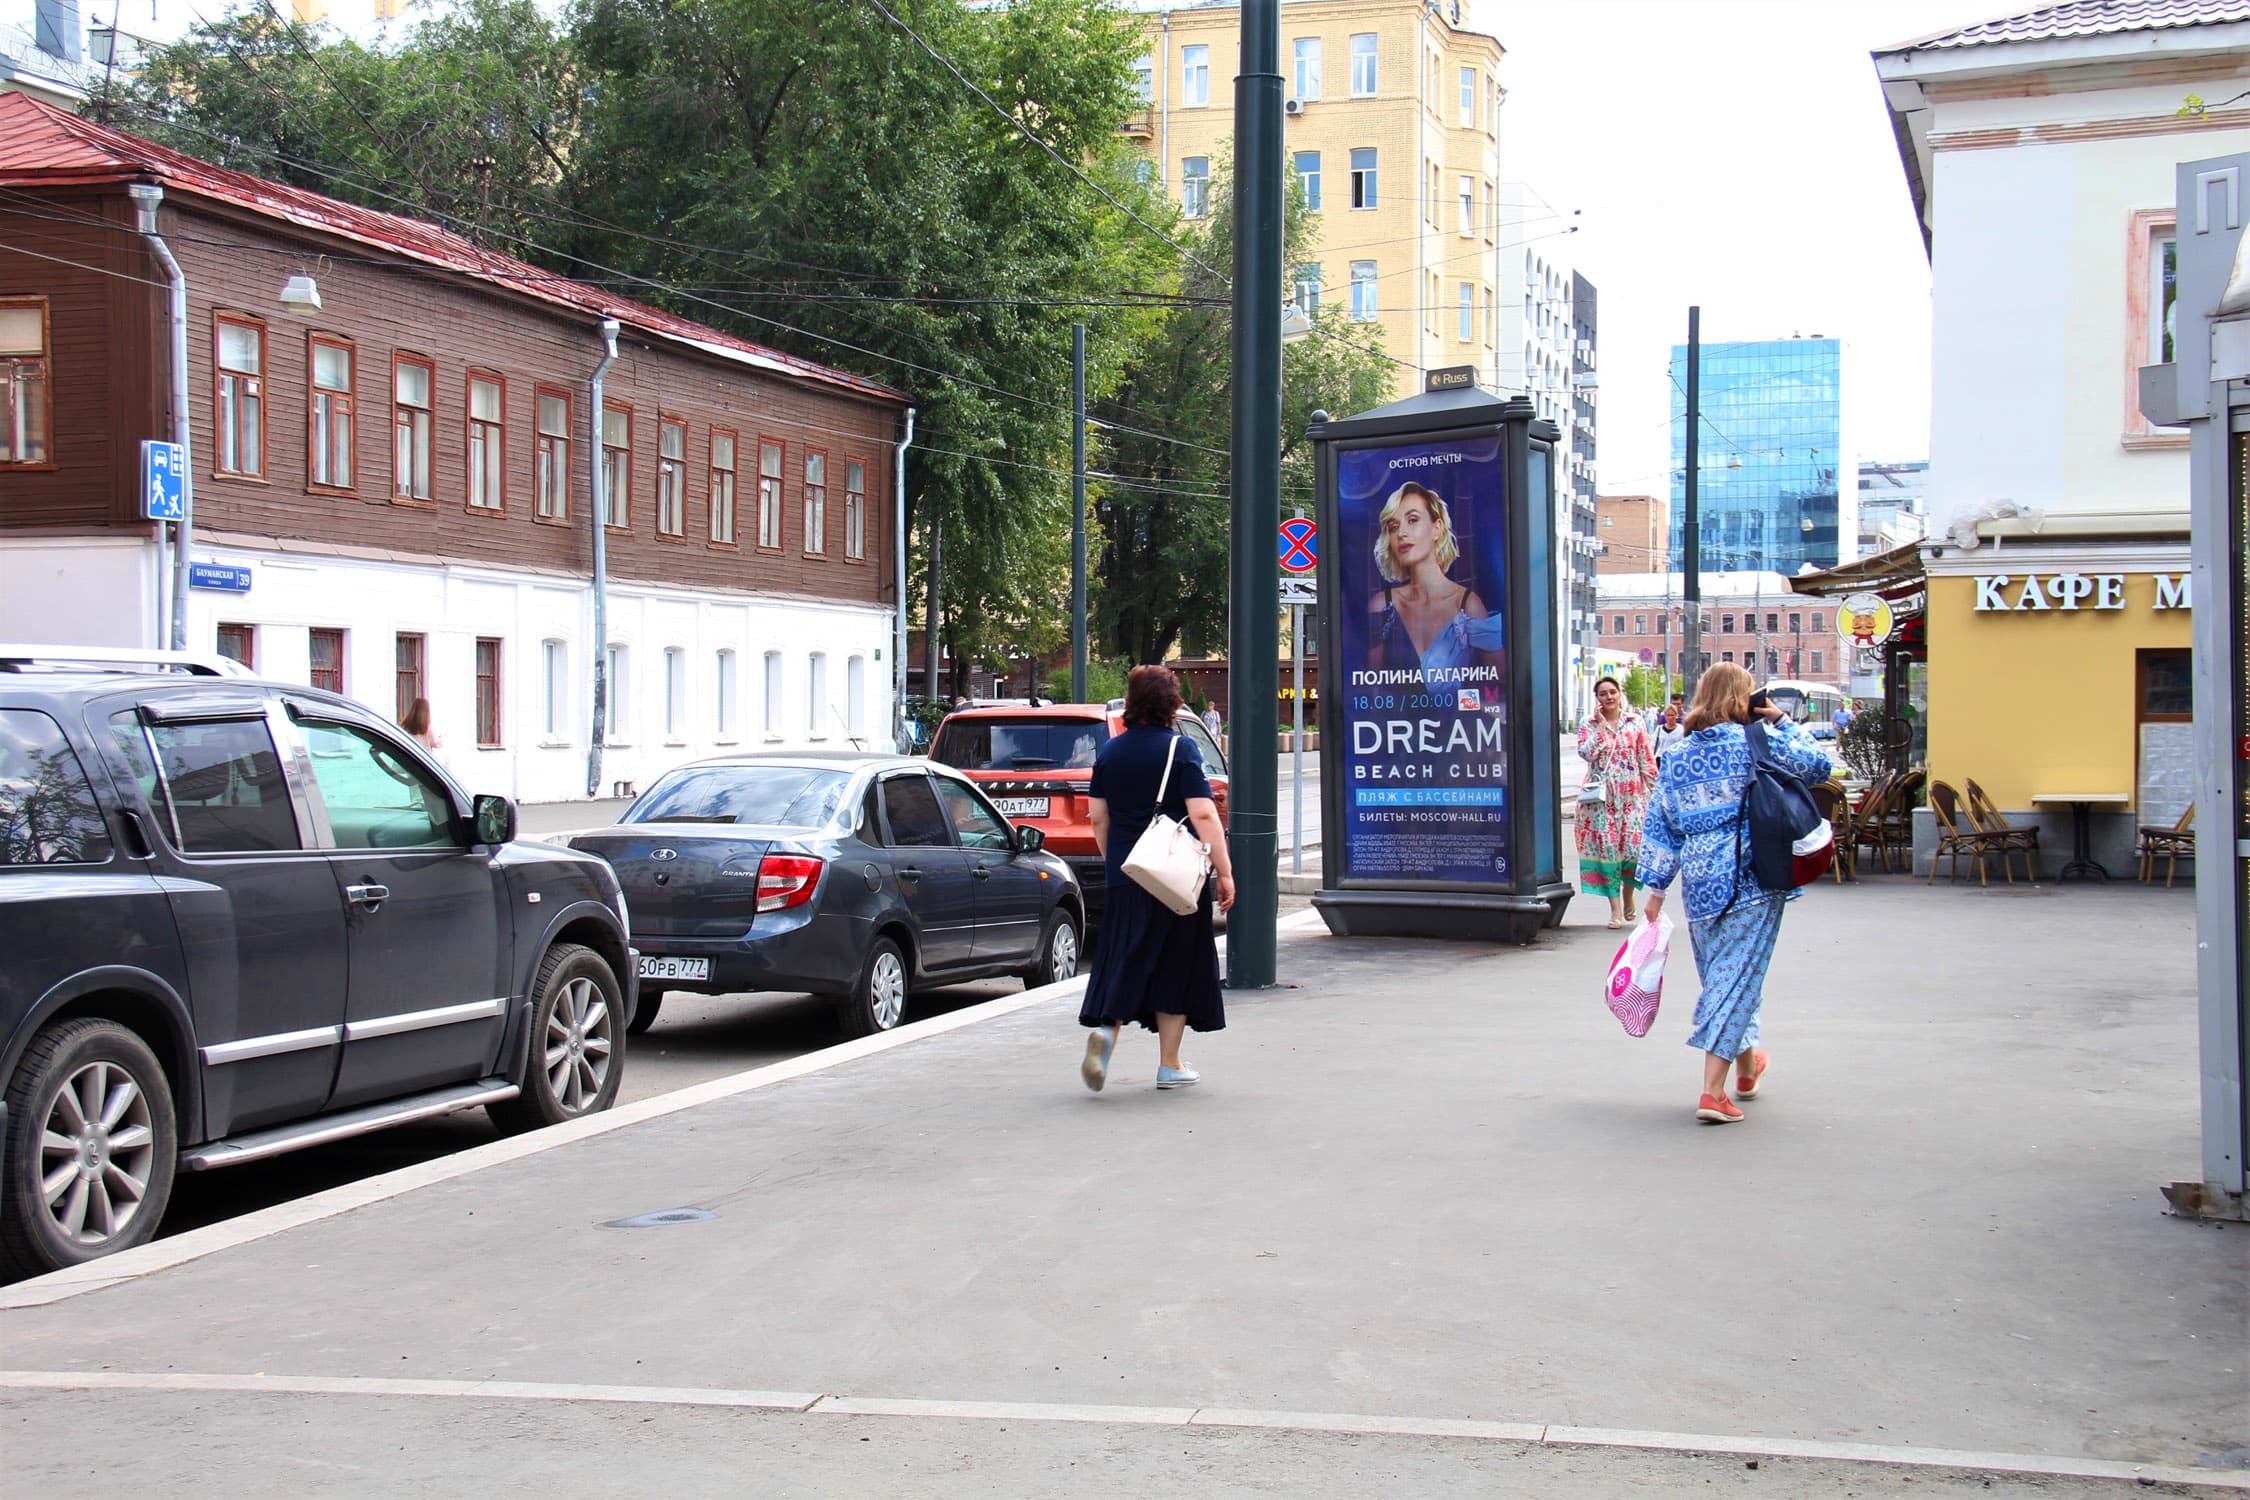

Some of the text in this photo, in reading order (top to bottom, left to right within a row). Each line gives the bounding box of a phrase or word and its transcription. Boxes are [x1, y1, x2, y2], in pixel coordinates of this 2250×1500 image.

[1442, 373, 1468, 385] Russ
[1388, 453, 1462, 469] ОСТРОВ МЕЧТЫ
[239, 573, 250, 586] 39
[1973, 573, 2127, 611] КАФЕ
[1352, 666, 1499, 686] ПОЛИНА ГАГАРИНА
[1353, 695, 1395, 710] 18.08
[1410, 693, 1454, 708] 20:00
[1353, 718, 1502, 754] DREAM
[1354, 763, 1503, 779] BEACH CLUB
[1026, 798, 1045, 808] 977
[1358, 789, 1500, 803] ПЛЯЖ С БАССЕЙНАМИ
[1359, 812, 1501, 822] БИЛЕТЫ: MOSCOW-HALL.RU
[721, 870, 754, 878] GRANTA
[681, 958, 704, 973] 777
